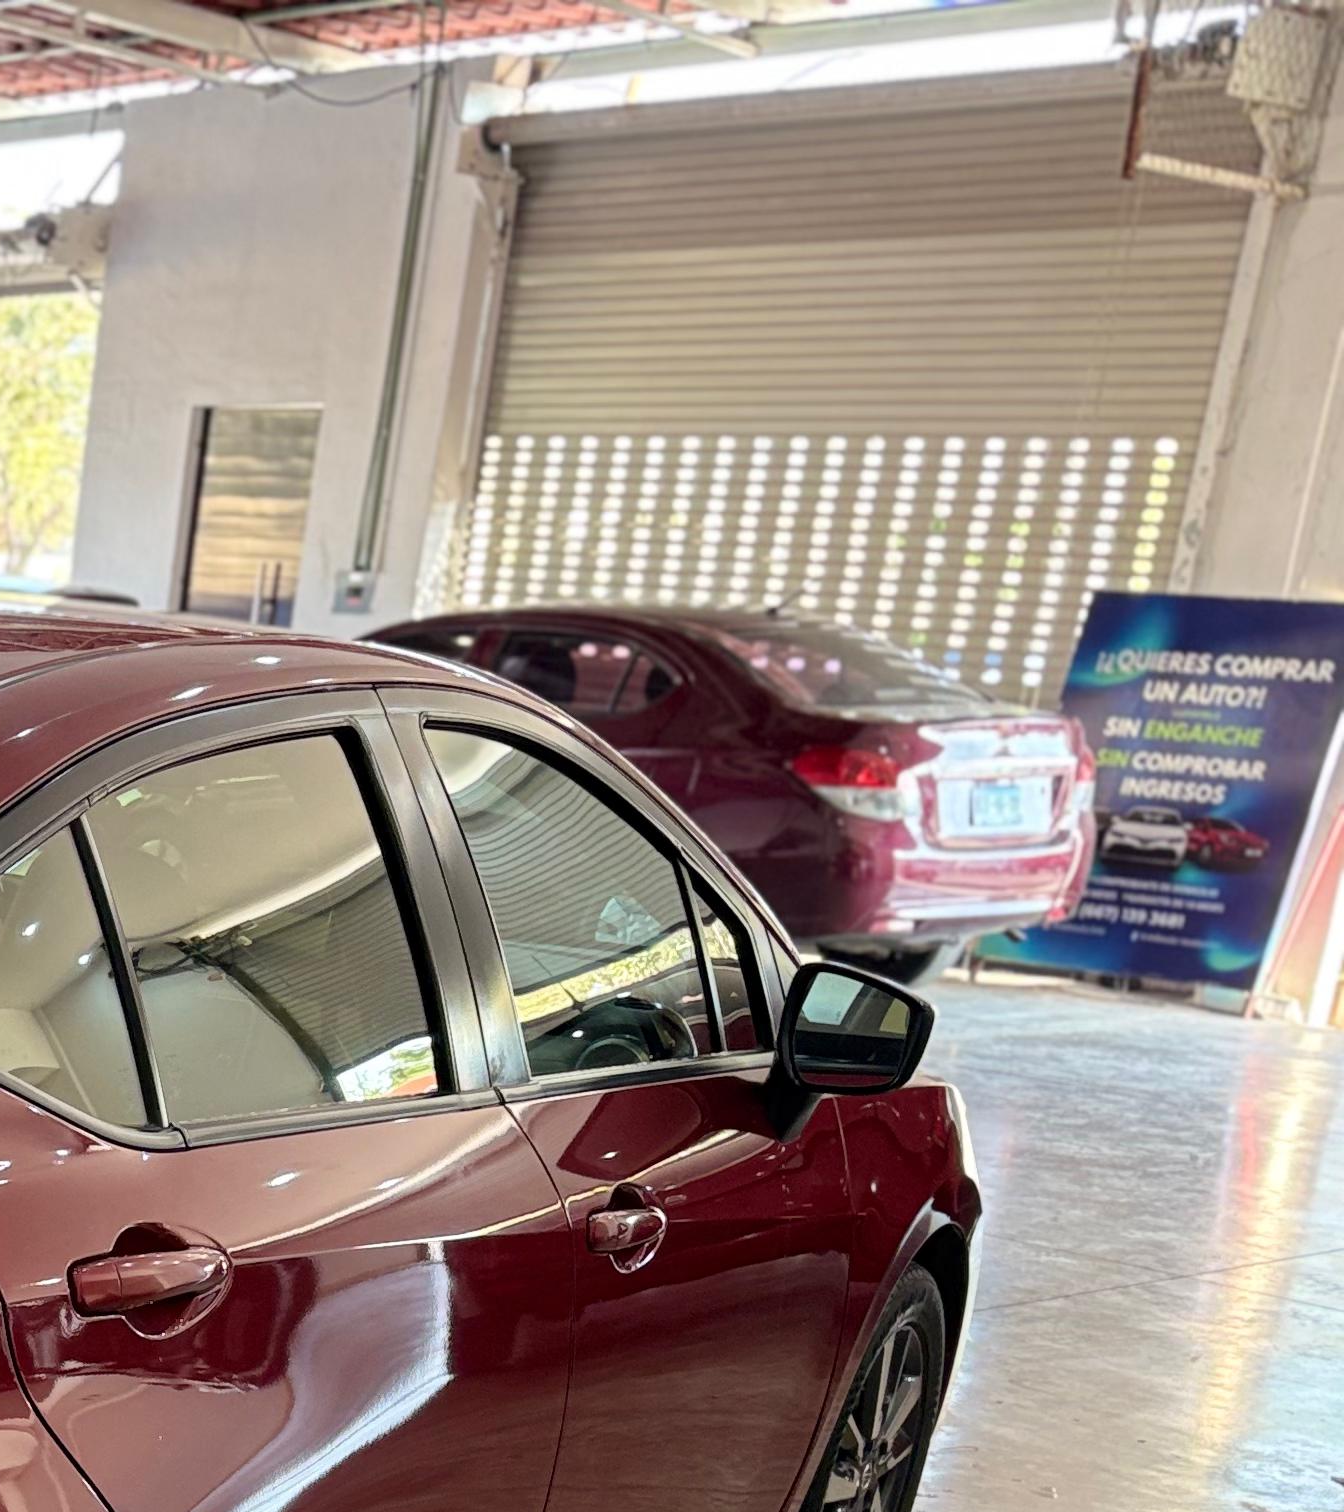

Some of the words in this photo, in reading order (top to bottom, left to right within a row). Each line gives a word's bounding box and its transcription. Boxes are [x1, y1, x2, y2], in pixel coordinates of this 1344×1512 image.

[1214, 655, 1335, 682] COMPRAR
[1143, 680, 1179, 702] UN
[1180, 683, 1267, 708] AUTO?!
[1103, 717, 1141, 738] SIN
[1143, 720, 1263, 747] ENGANCHE
[1096, 748, 1130, 767] SIN
[1132, 752, 1266, 780] COMPROBAR
[1120, 777, 1226, 804] INGRESOS
